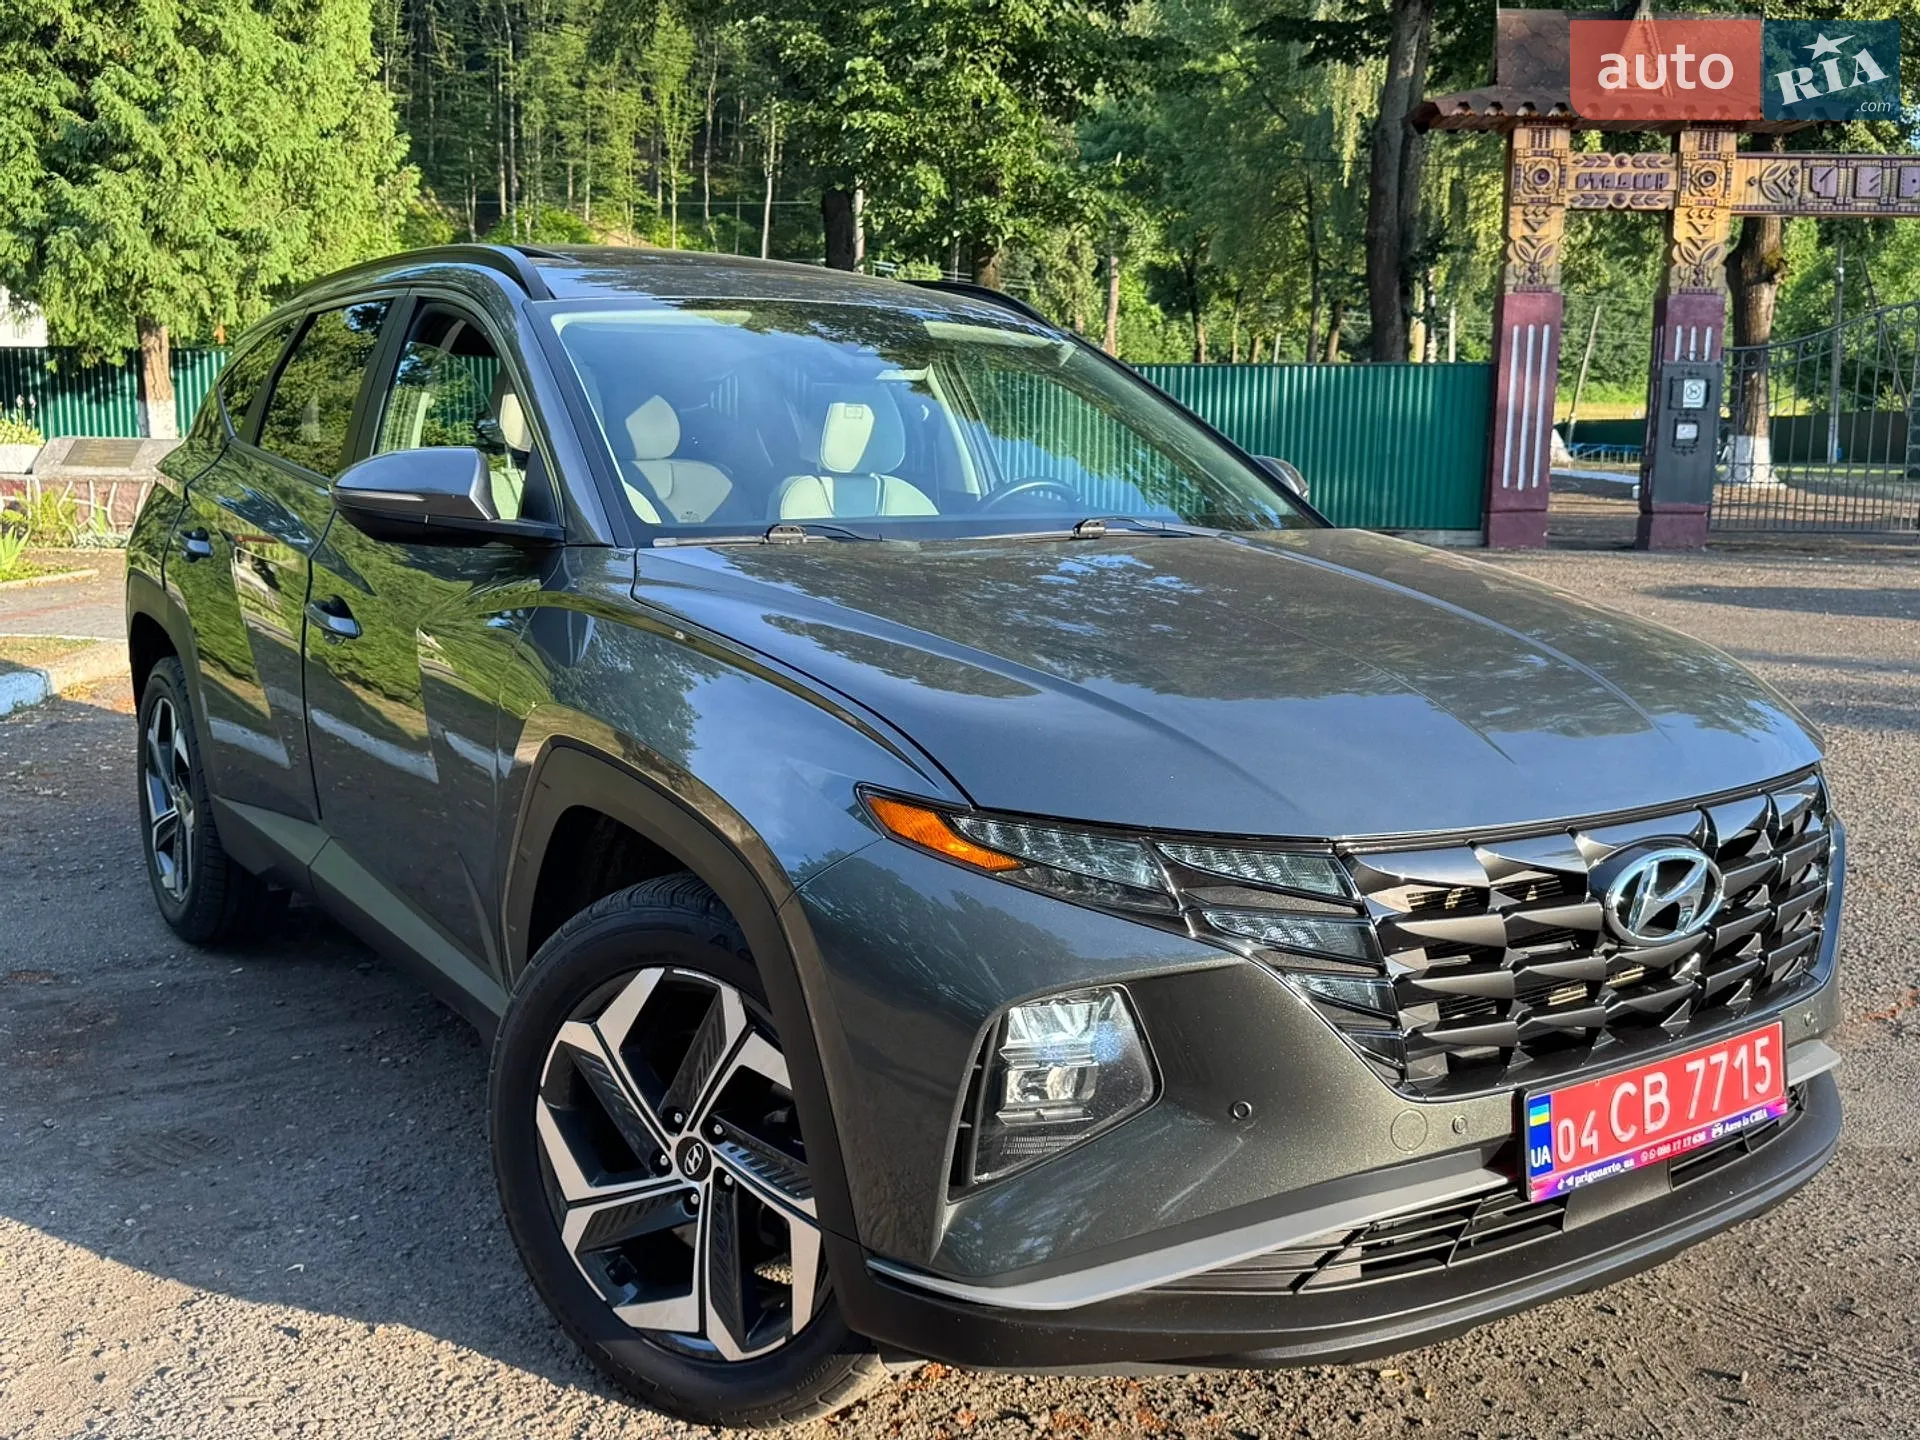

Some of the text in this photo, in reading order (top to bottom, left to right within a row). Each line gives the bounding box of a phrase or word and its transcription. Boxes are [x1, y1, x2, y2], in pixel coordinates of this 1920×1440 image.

[1557, 1036, 1773, 1164] 04 CB 7715
[1530, 1144, 1552, 1168] UA
